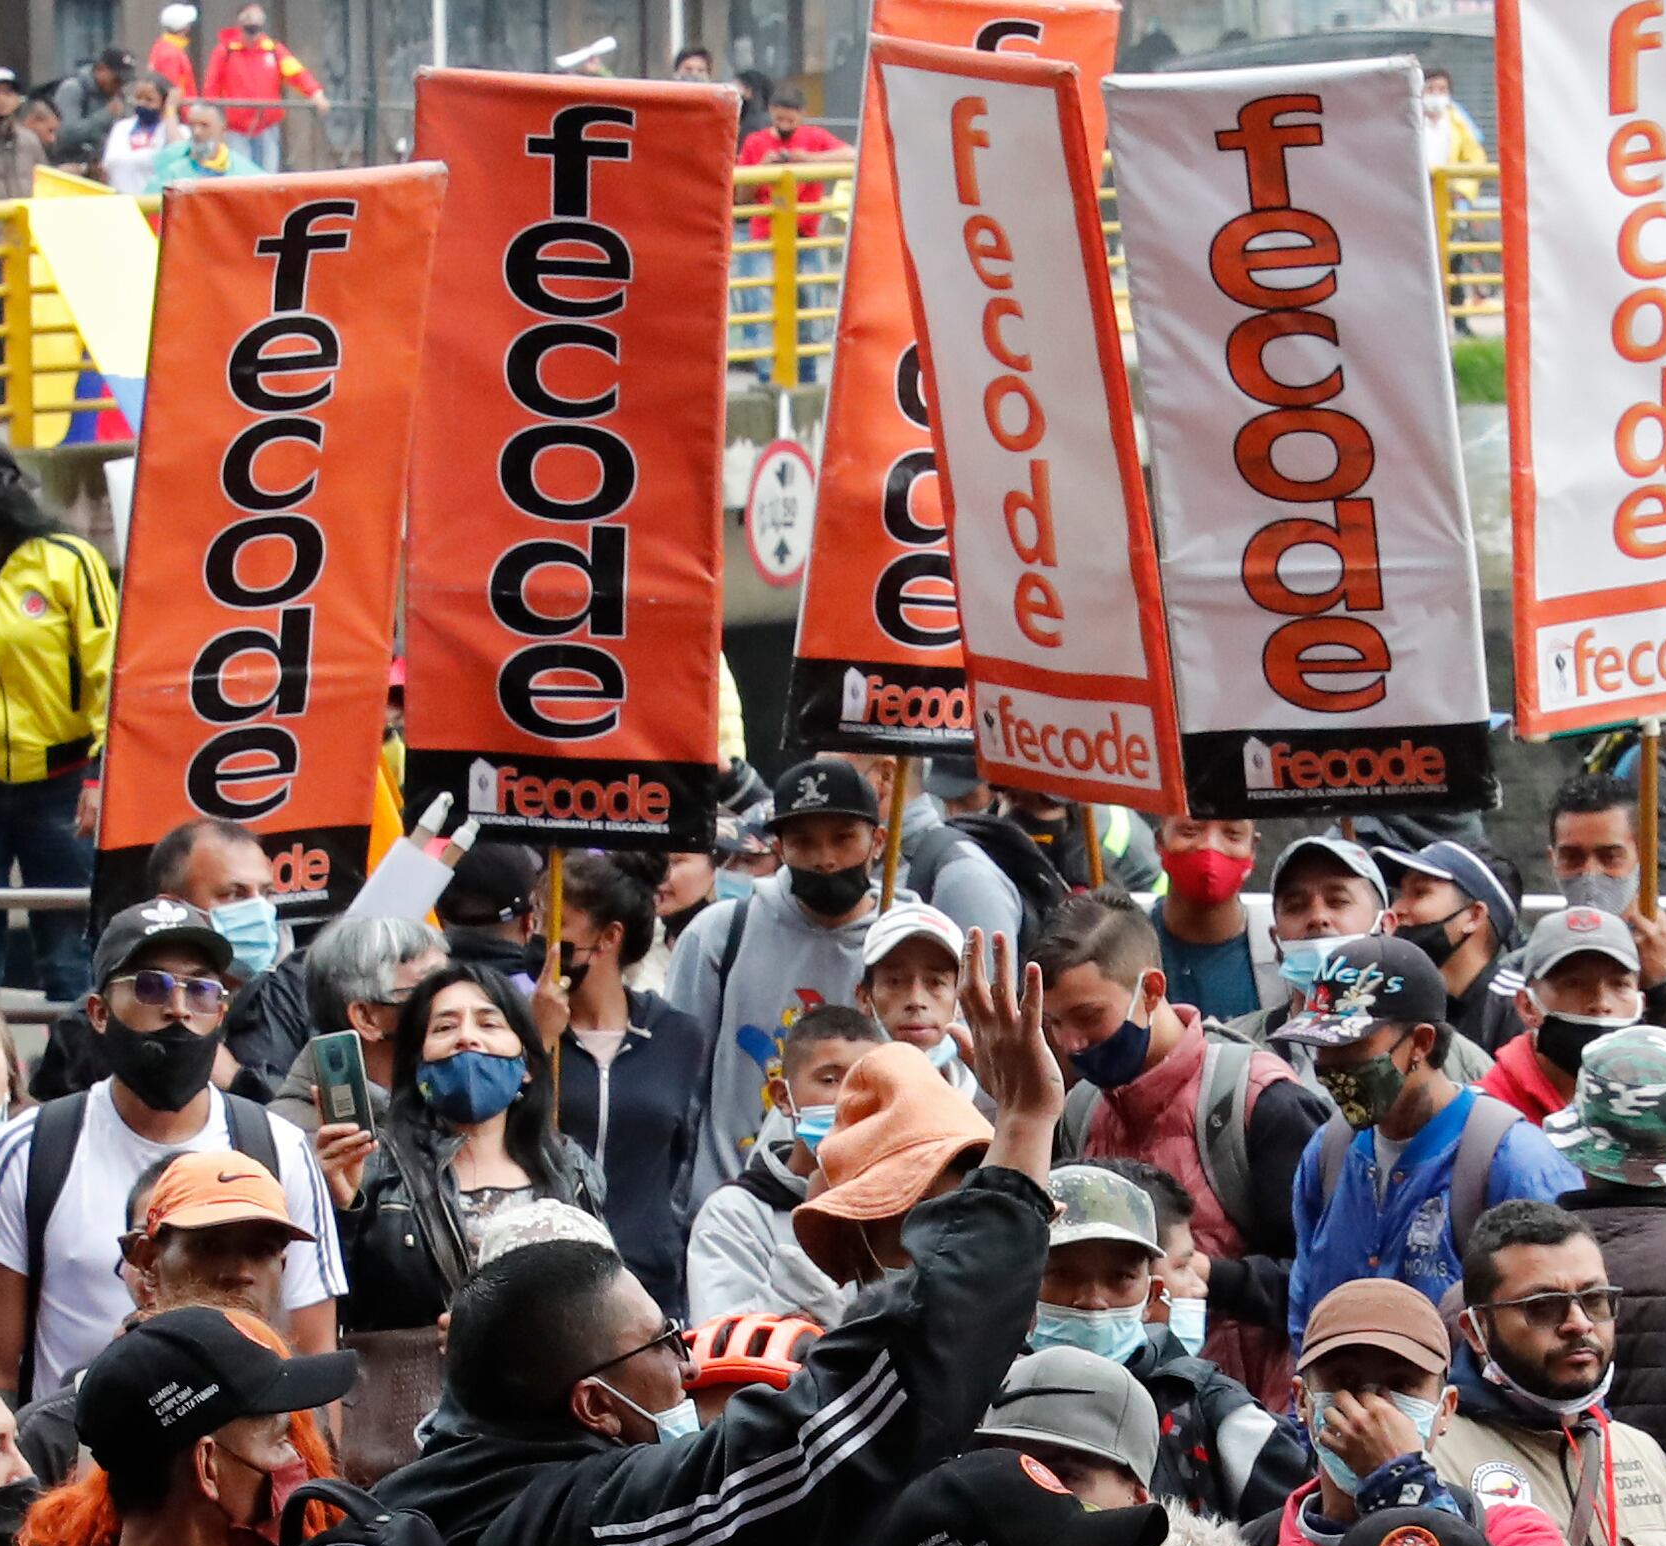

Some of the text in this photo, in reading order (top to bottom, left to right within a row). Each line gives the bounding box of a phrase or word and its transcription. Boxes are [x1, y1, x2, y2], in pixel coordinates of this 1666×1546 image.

[184, 200, 359, 823] fecode
[487, 103, 638, 742] fecode
[950, 95, 1066, 650] fecode
[1209, 93, 1394, 714] fecode
[496, 766, 671, 824] fecode
[862, 674, 973, 729] fecod
[998, 694, 1151, 781] fecode
[1270, 739, 1447, 790] fecode
